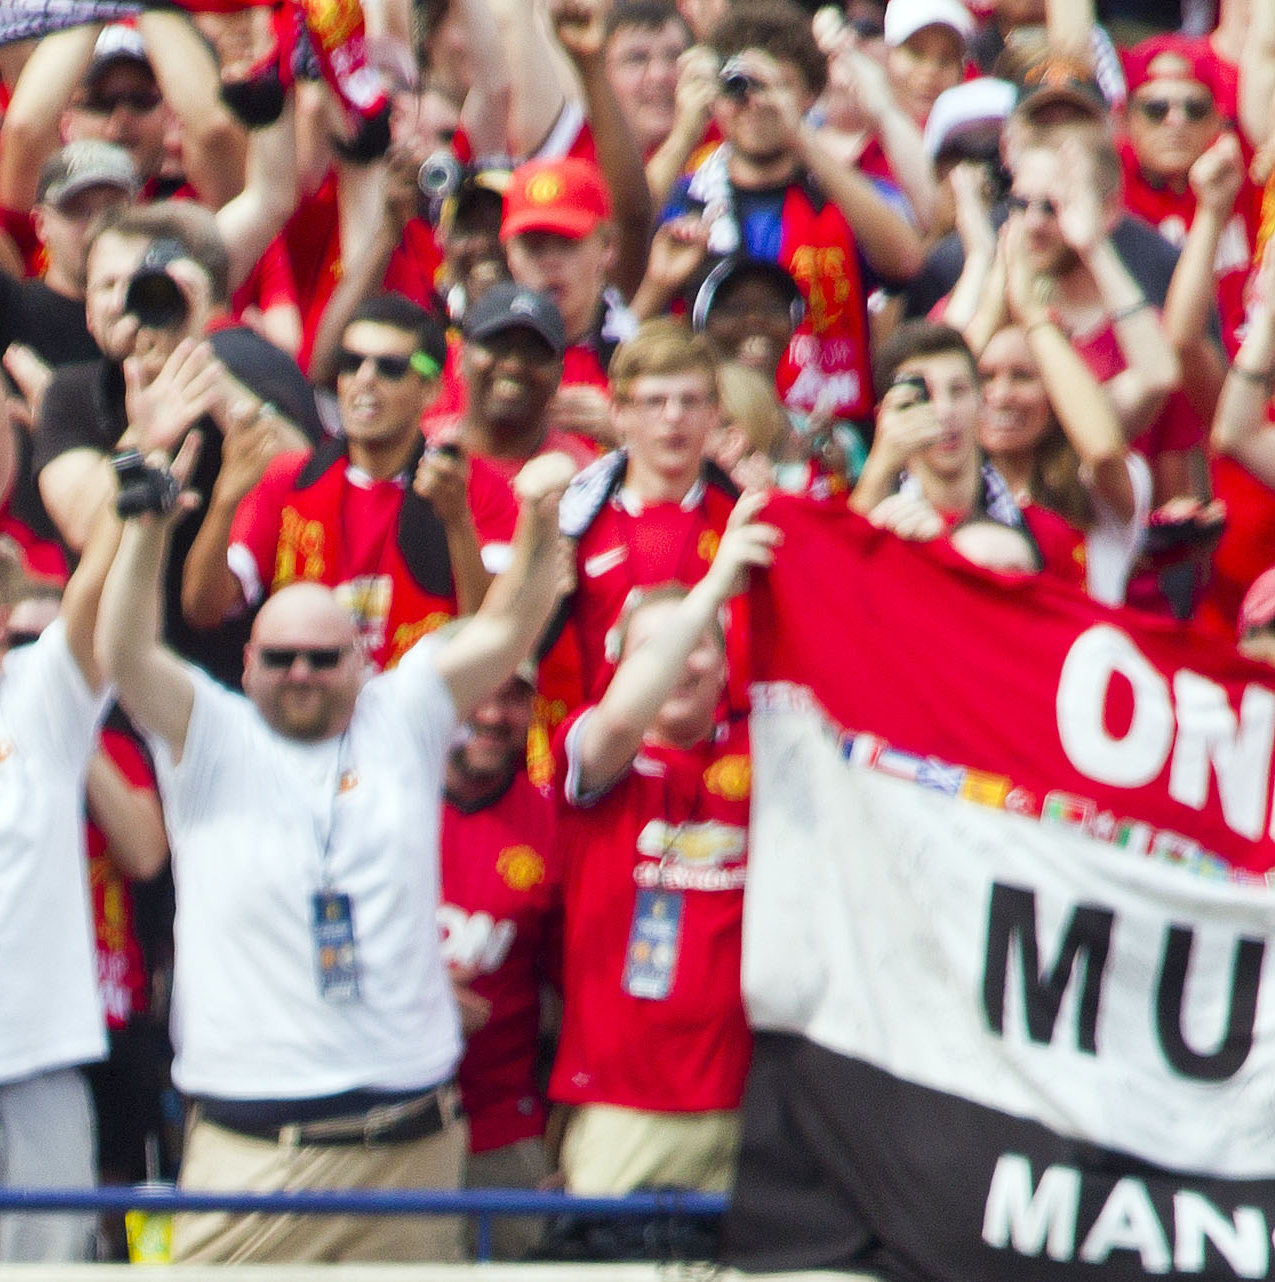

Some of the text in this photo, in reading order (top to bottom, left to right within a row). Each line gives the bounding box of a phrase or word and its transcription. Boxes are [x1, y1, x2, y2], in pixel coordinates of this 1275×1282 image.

[1056, 623, 1275, 843] ON
[435, 902, 517, 973] ON
[981, 881, 1265, 1084] MU
[981, 1152, 1275, 1280] MAN
